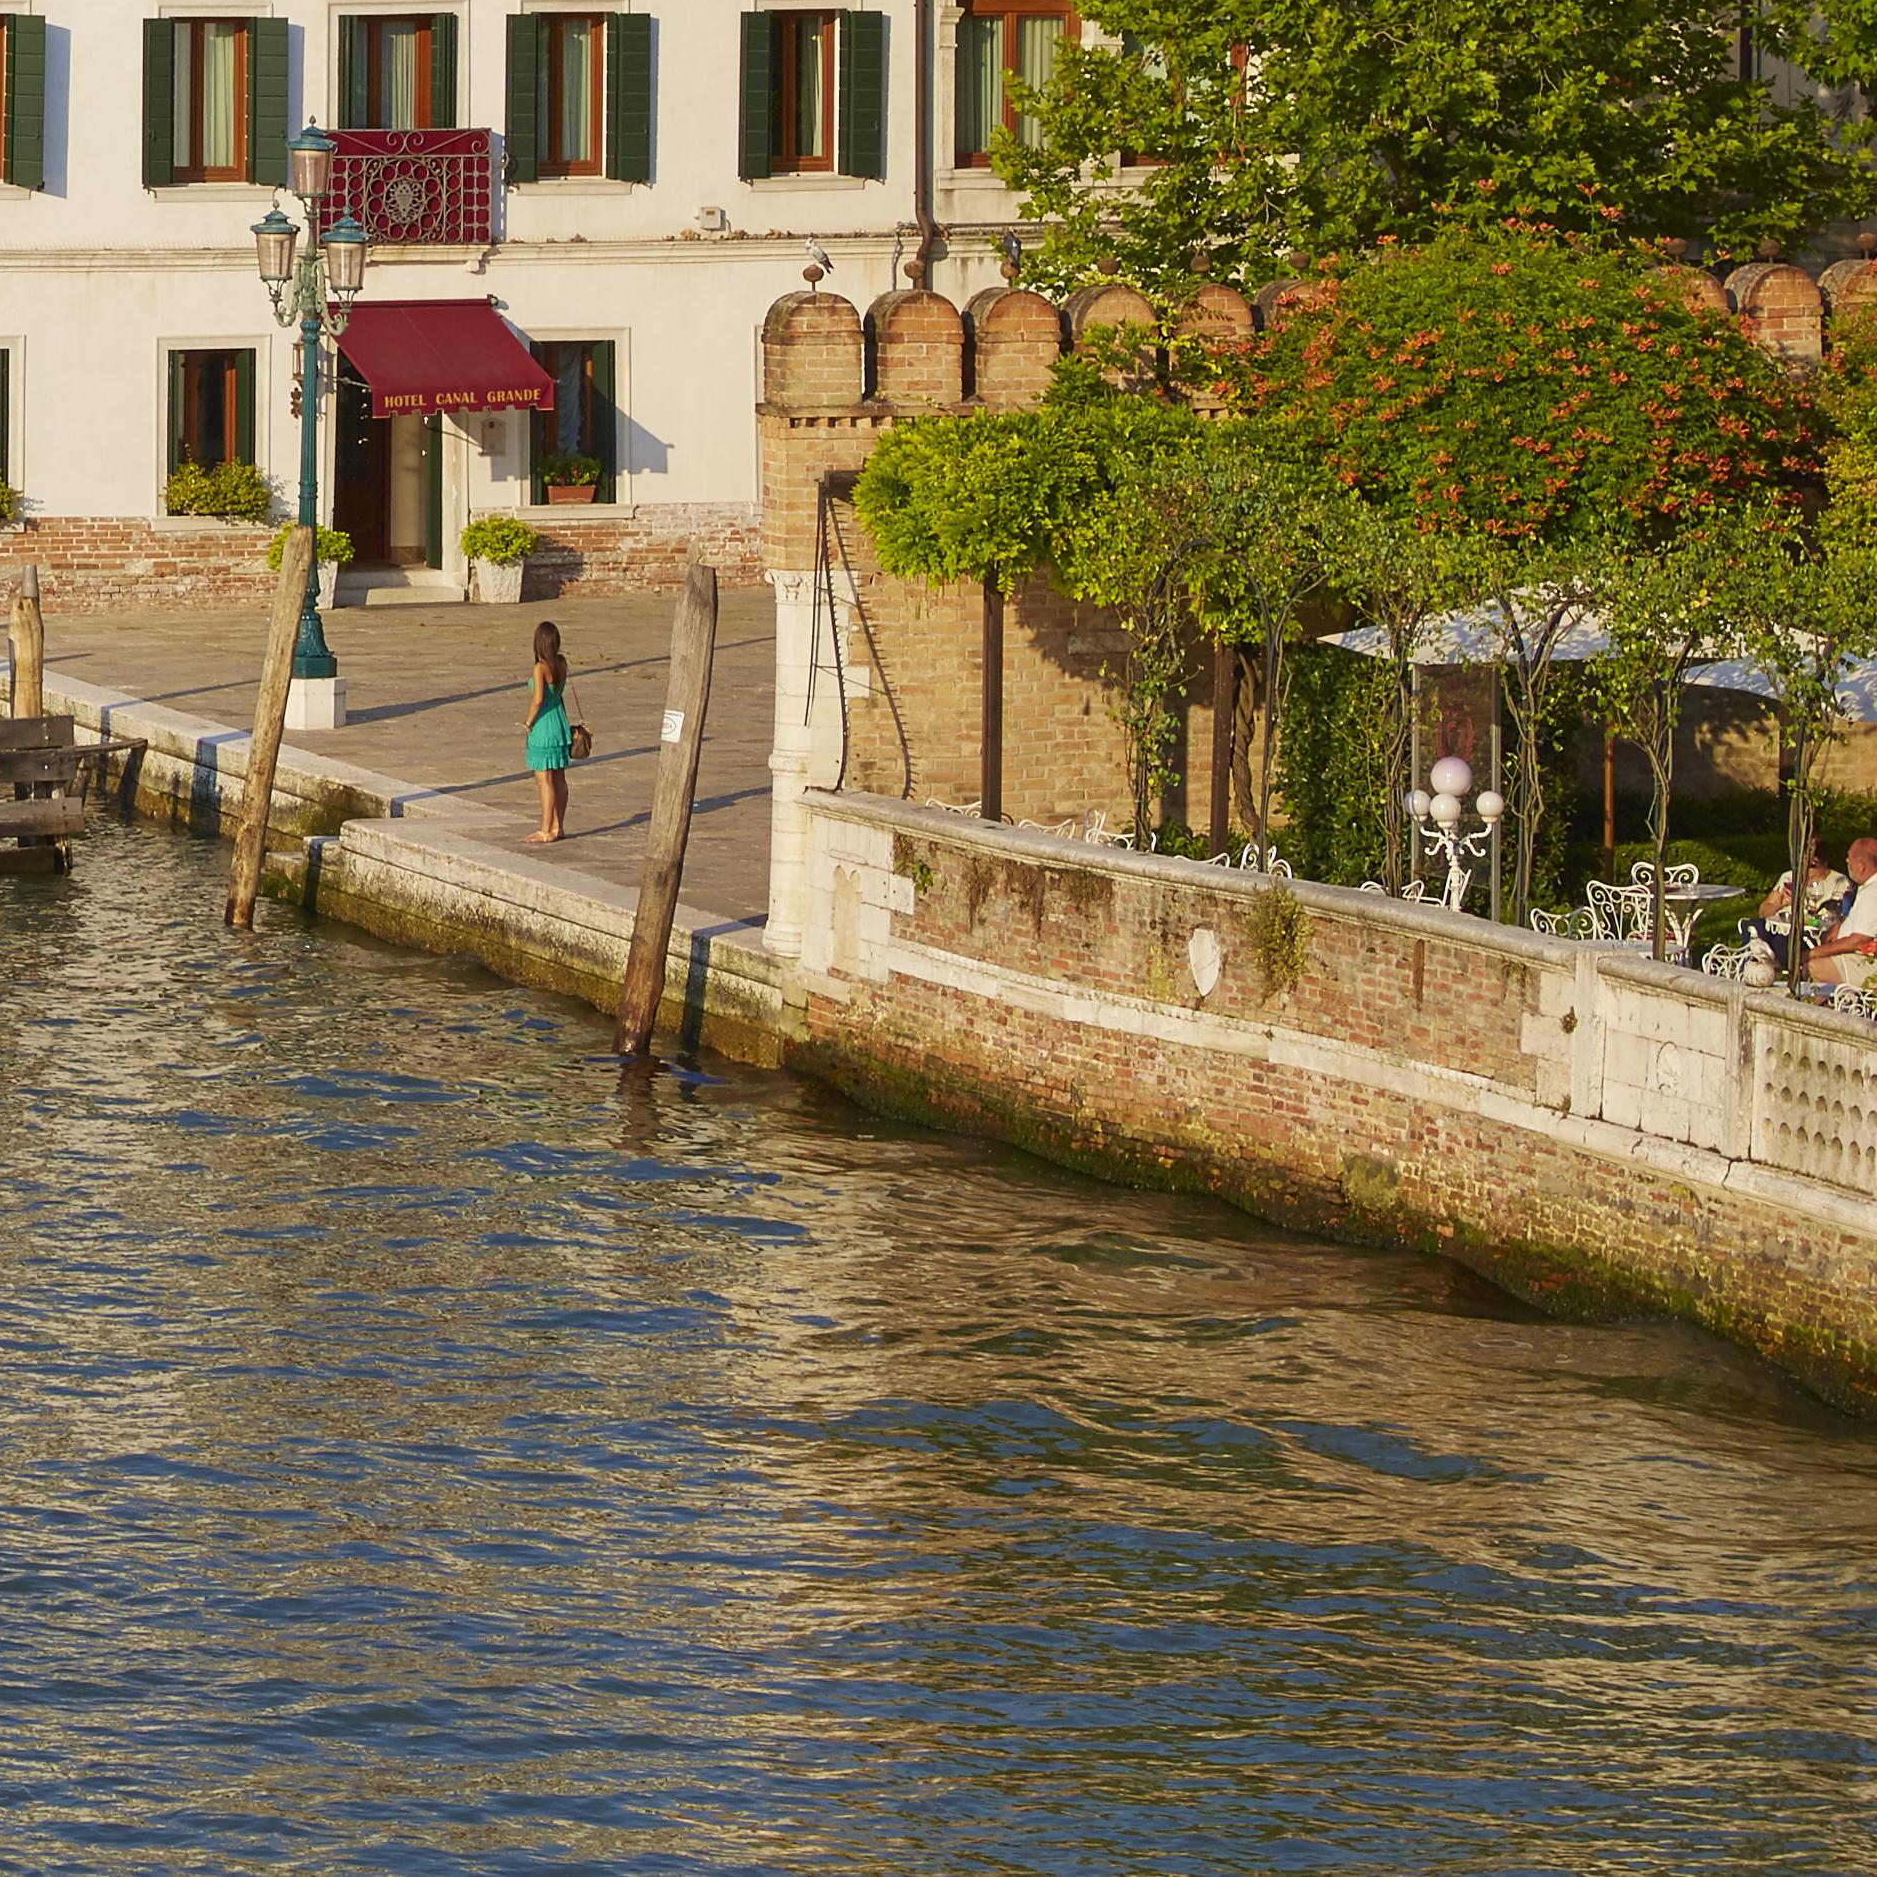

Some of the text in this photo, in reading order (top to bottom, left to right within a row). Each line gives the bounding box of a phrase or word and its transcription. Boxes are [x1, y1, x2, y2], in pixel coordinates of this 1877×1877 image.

[384, 388, 542, 408] HOTEL CANAL GRANDE
